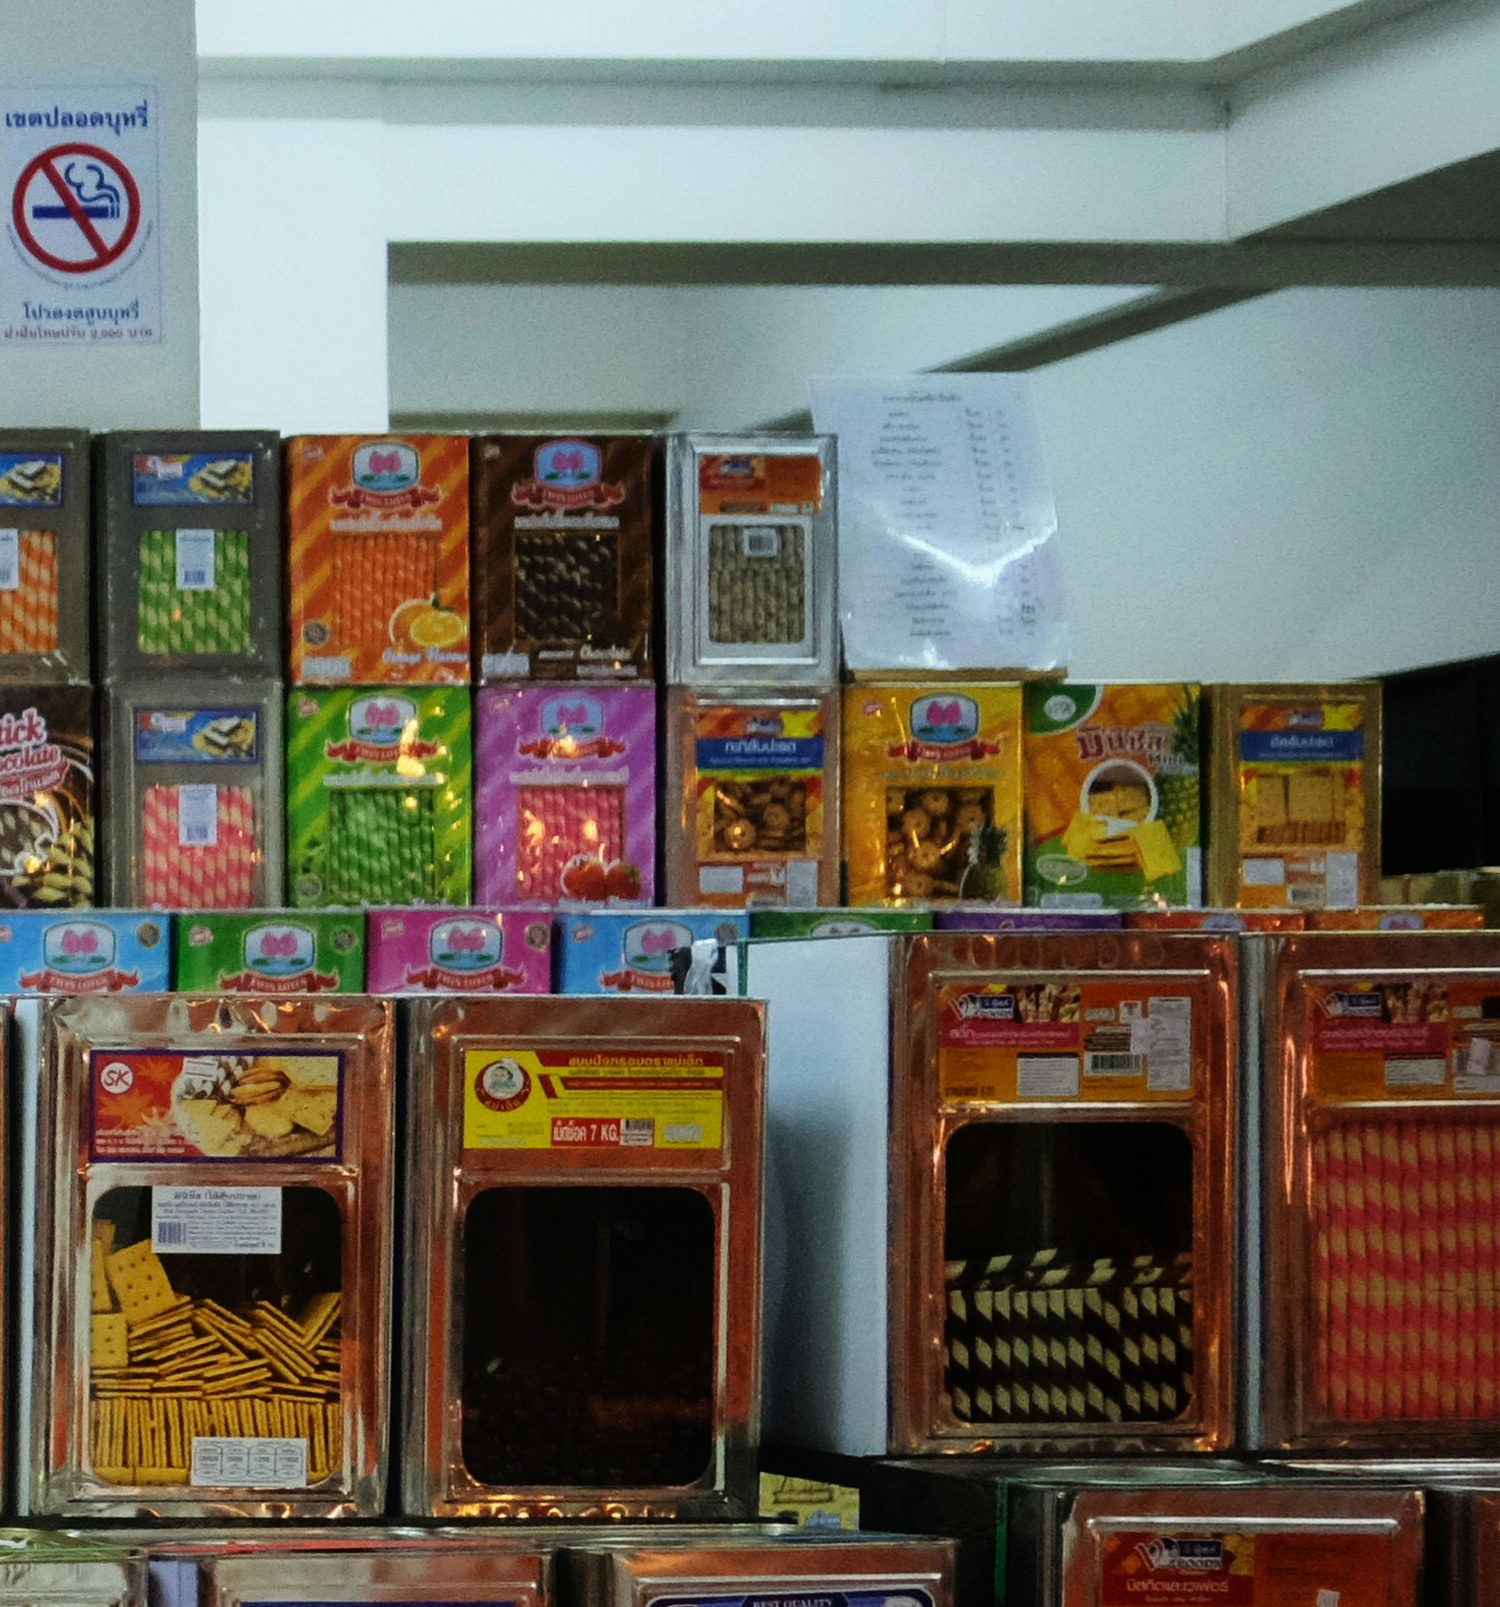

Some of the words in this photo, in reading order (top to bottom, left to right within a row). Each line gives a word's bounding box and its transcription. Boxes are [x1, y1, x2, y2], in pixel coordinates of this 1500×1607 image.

[6, 99, 149, 136] เขตปลอดบุหรี่
[104, 1070, 130, 1087] SK
